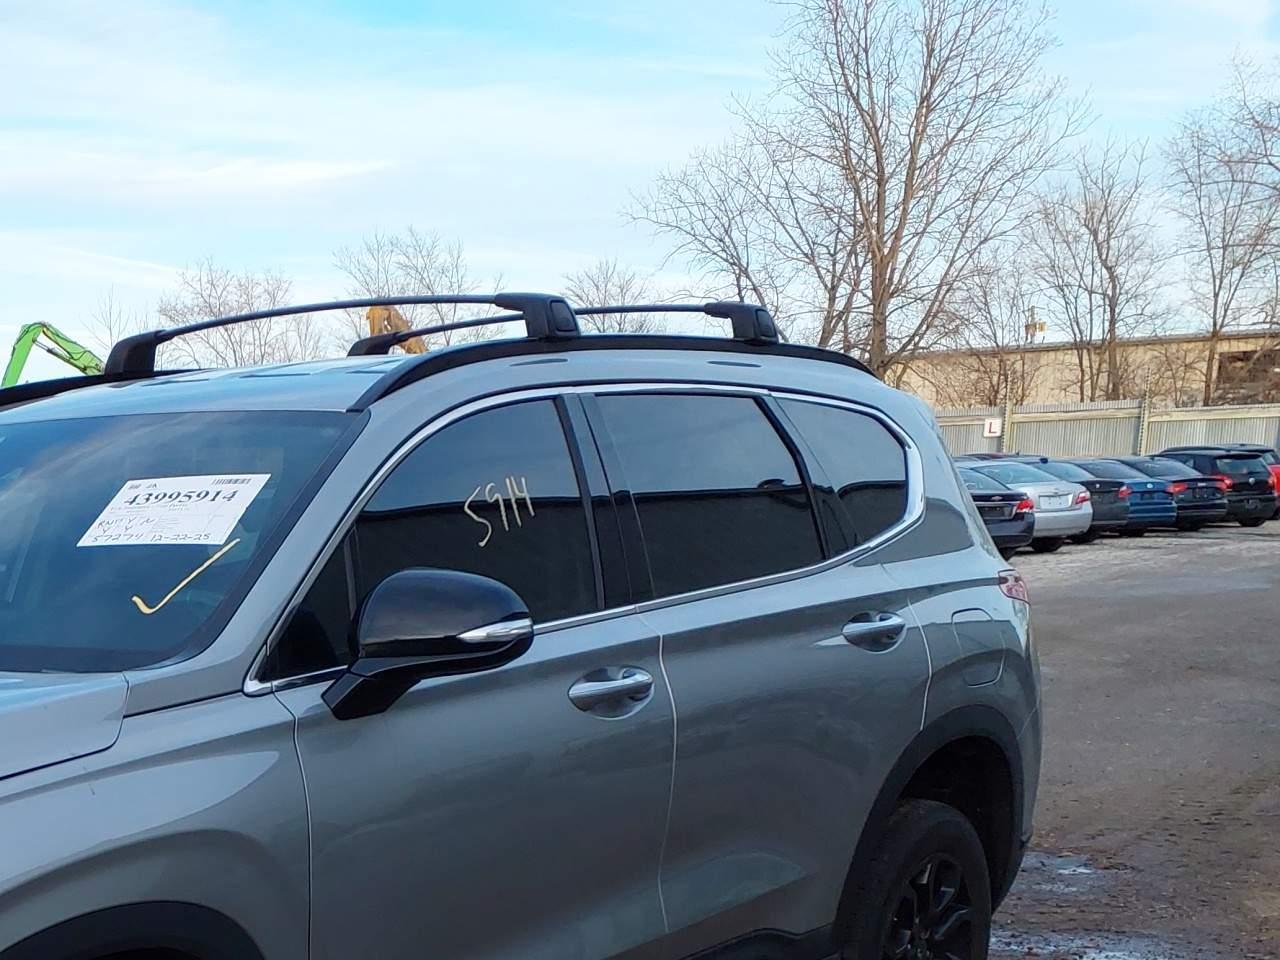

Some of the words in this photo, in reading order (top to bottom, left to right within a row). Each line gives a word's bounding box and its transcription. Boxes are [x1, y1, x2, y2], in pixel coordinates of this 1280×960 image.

[988, 421, 998, 434] L
[124, 489, 239, 506] 43995914
[463, 475, 535, 547] 5914
